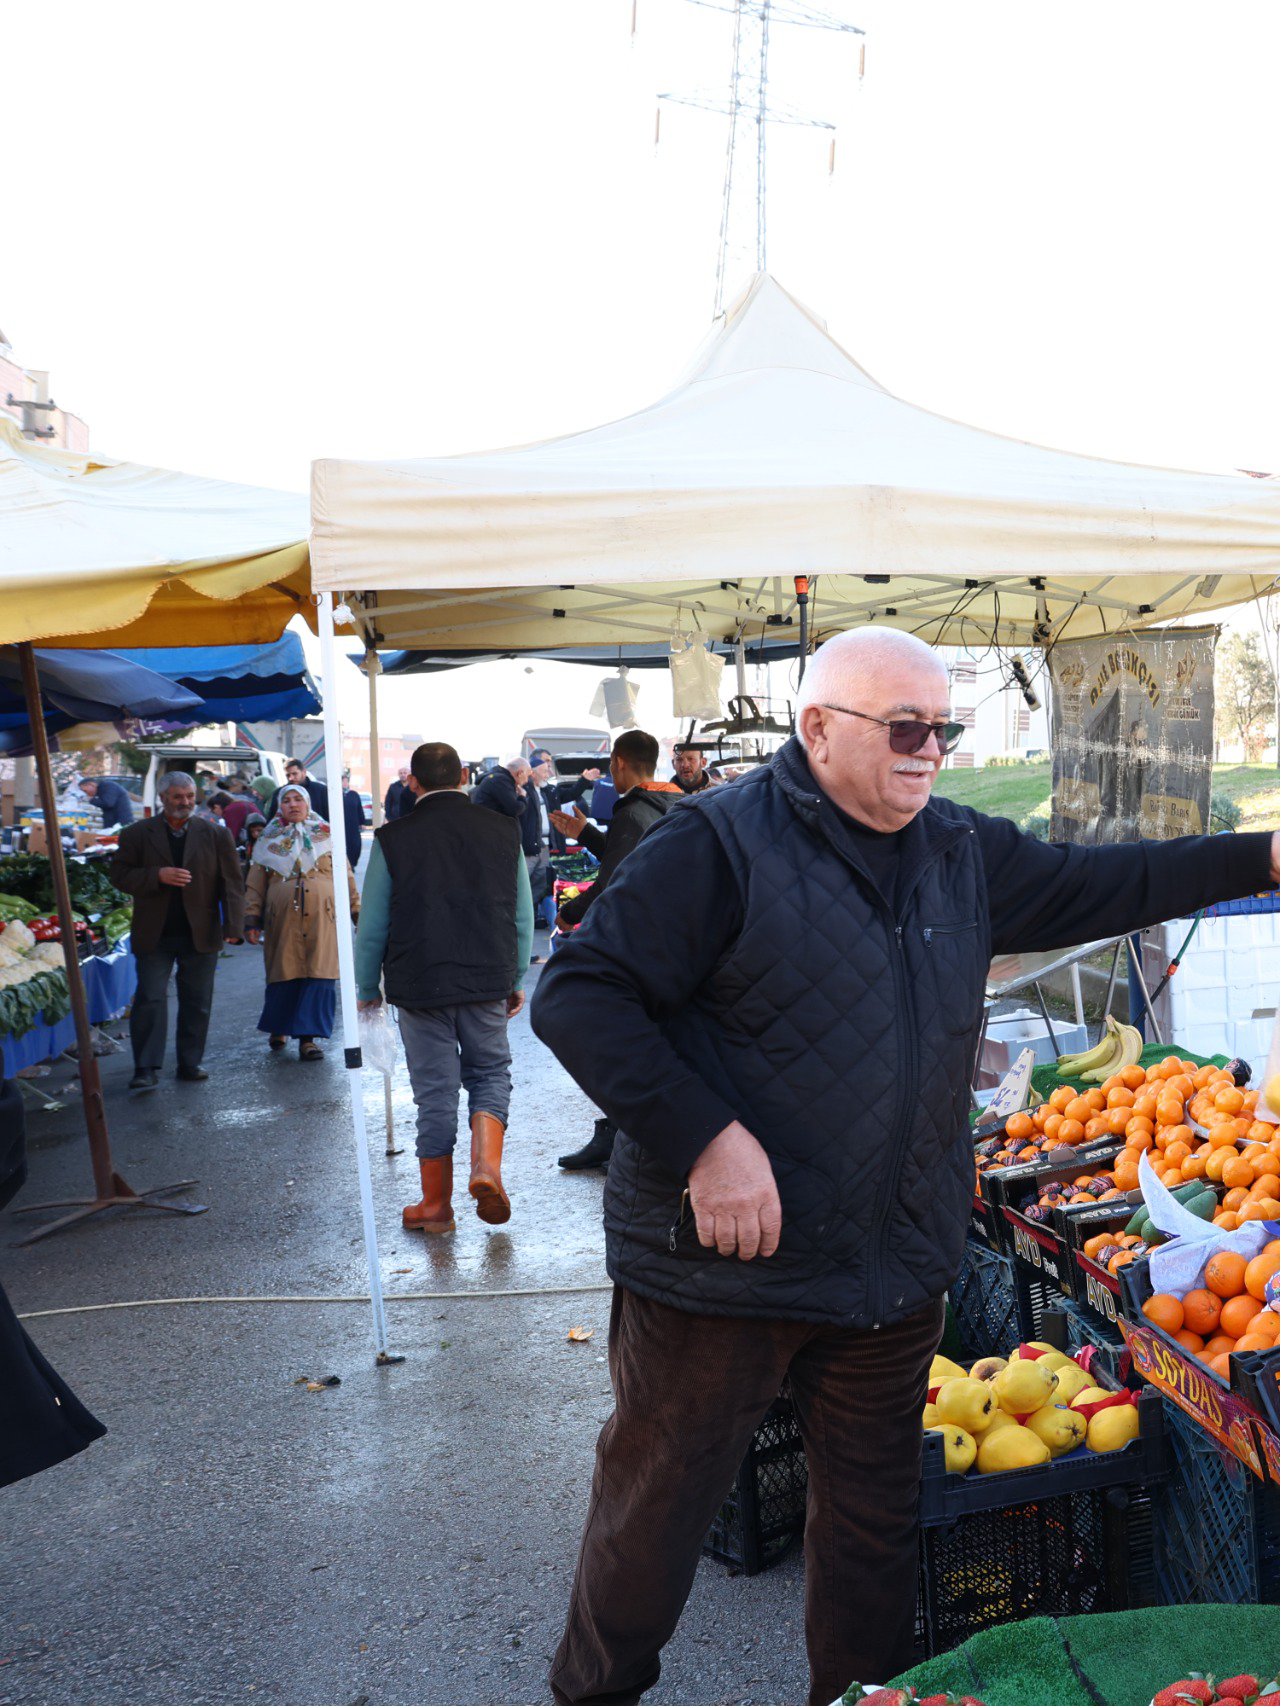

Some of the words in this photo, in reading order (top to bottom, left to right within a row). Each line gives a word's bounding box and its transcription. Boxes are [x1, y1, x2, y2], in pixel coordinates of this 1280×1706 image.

[1085, 1147, 1113, 1160] AYD
[1080, 1208, 1113, 1219] AYD
[1013, 1225, 1042, 1268] AYD
[1086, 1272, 1117, 1323] AYD
